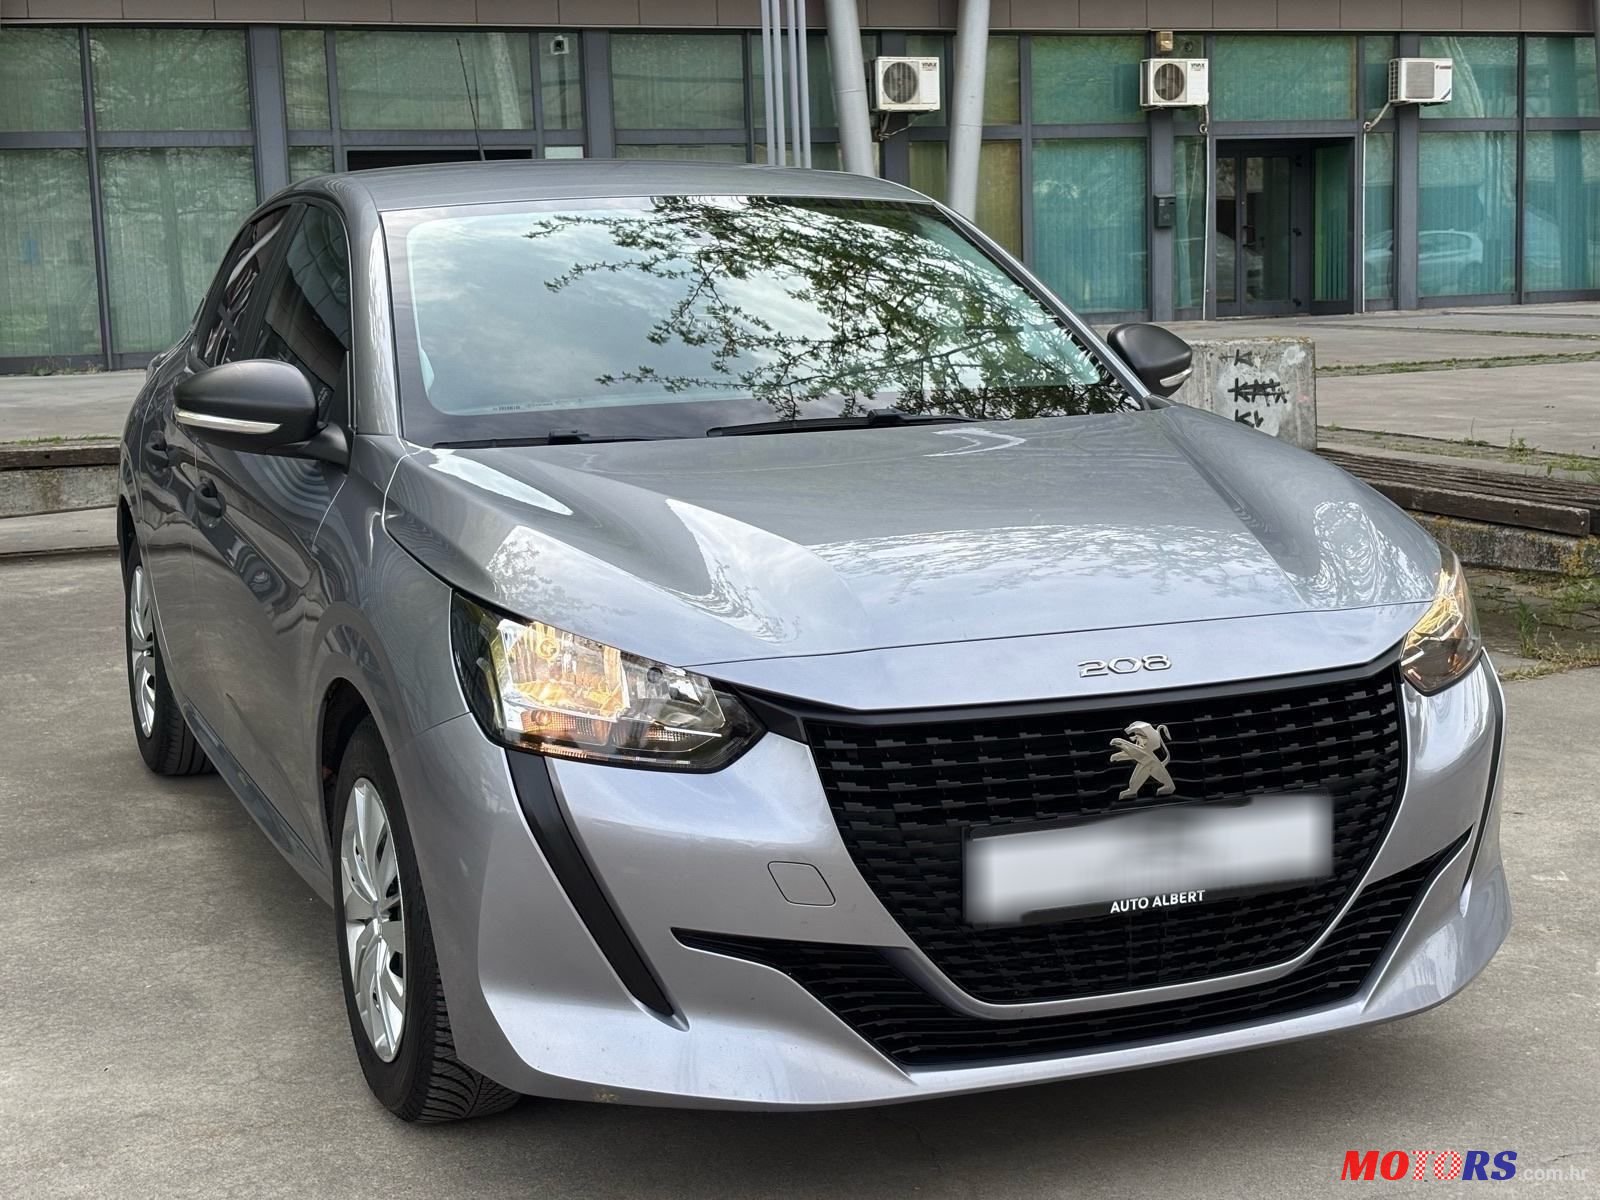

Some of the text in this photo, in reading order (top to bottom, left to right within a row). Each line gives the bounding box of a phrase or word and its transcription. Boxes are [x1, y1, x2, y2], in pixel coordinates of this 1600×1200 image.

[1078, 654, 1172, 678] 208
[1110, 889, 1206, 914] AUTO ALBERT
